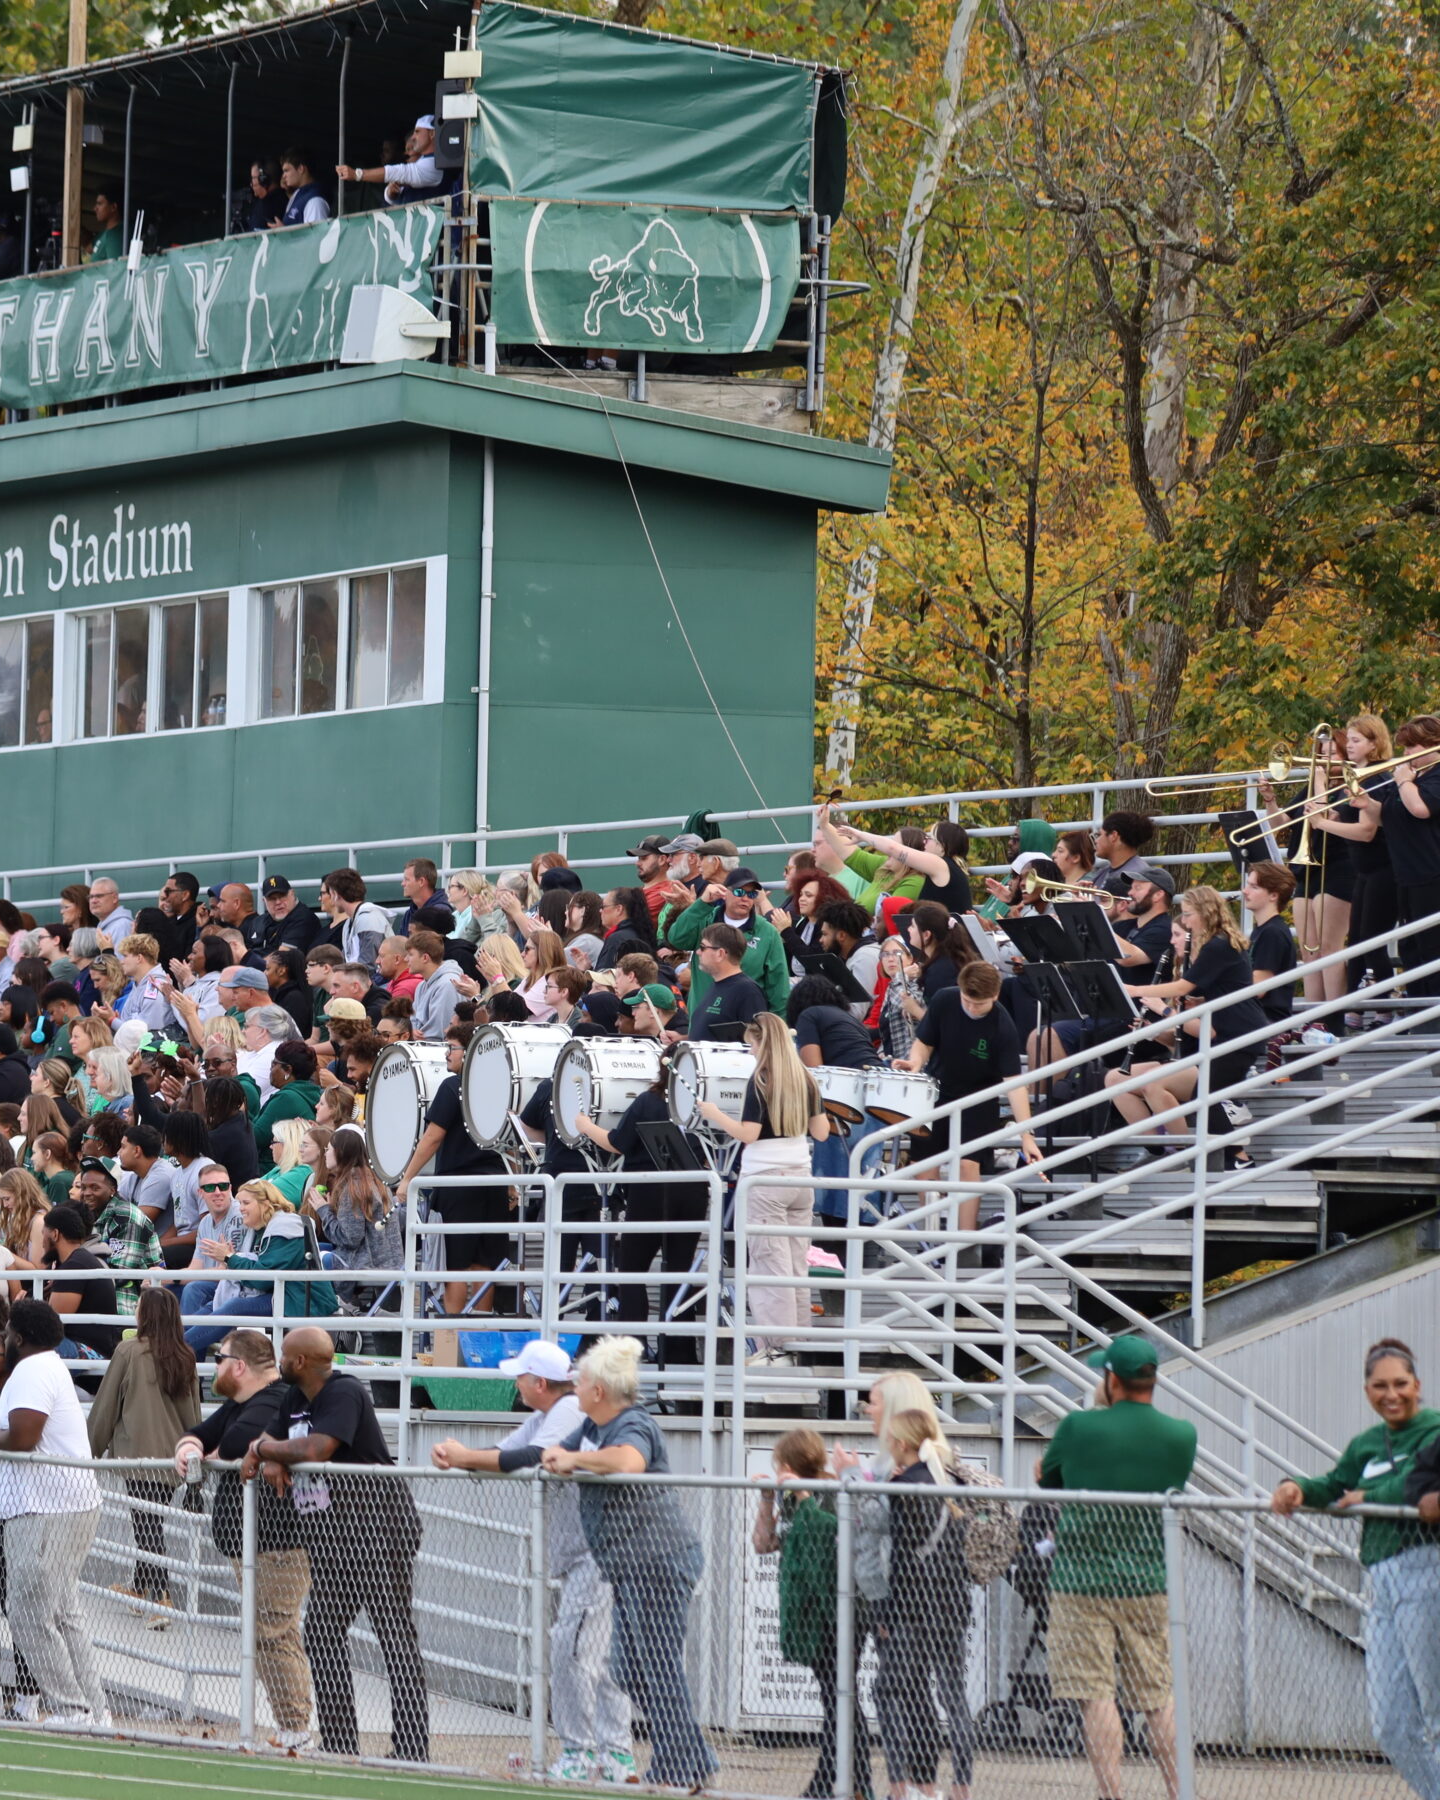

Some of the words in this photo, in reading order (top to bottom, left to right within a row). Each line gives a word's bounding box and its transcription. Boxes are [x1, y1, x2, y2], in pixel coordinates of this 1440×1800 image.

[47, 502, 194, 592] Stadium
[483, 1039, 503, 1053] YAMAHA
[389, 1060, 410, 1078] YAMAHA
[620, 1061, 646, 1070] YAMAHA
[720, 1091, 743, 1099] AMAHA
